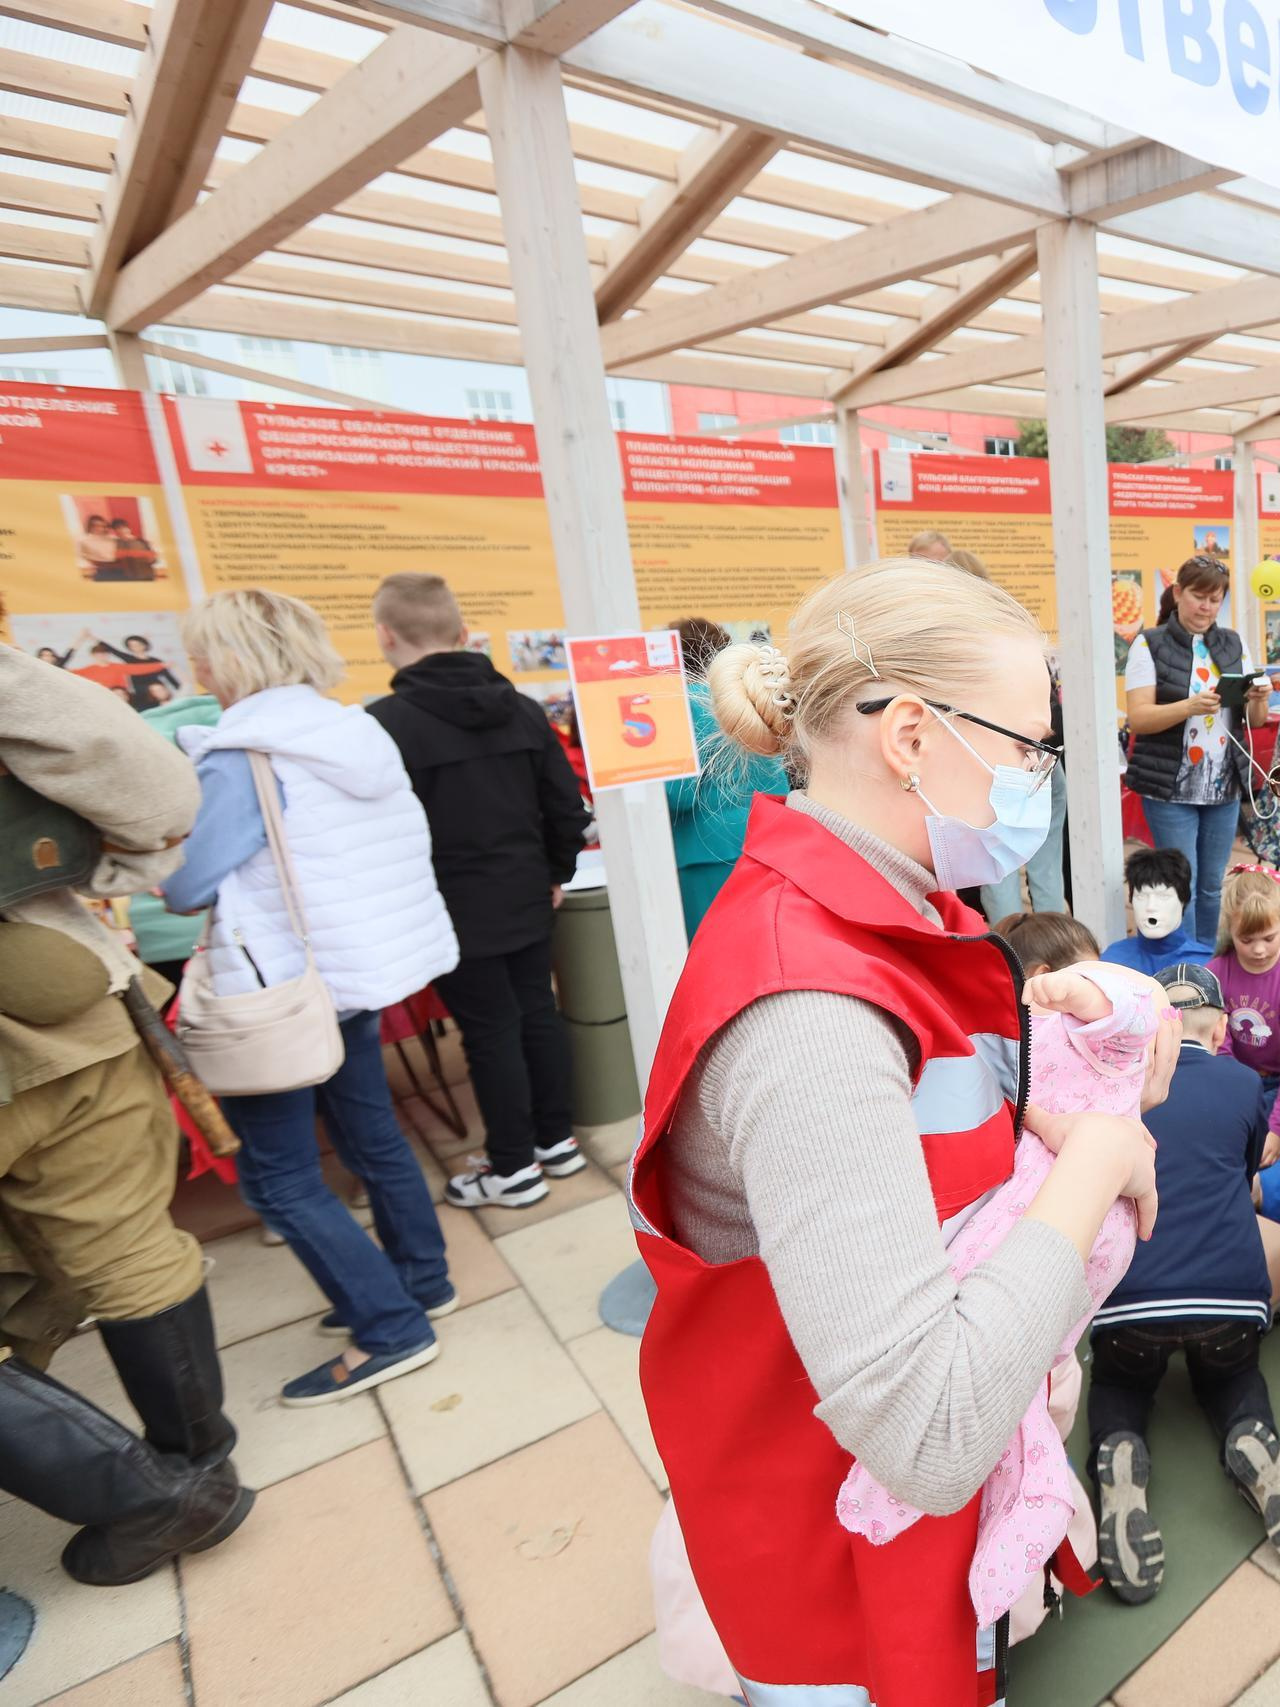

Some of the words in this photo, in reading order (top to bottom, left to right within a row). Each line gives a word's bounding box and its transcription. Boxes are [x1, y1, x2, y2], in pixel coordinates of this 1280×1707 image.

[255, 413, 341, 432] ТУЛЬСКОЕ
[342, 419, 432, 438] ОБЛАСТНОЕ
[433, 425, 515, 443] ОТДЕЛЕНИЕ
[258, 429, 411, 451] ОБЩЕРОССИЙСКОЙ
[412, 440, 526, 458] ОБЩЕСТВЕННОЙ
[261, 446, 378, 465] ОРГАНИЗАЦИИ
[628, 454, 680, 467] ОБЛАСТИ
[743, 449, 796, 462] ТУЛЬСКОЙ
[630, 467, 719, 482] ОБЩЕСТВЕННАЯ
[720, 472, 792, 486] ОРГАНИЗАЦИЯ
[617, 693, 657, 748] 5
